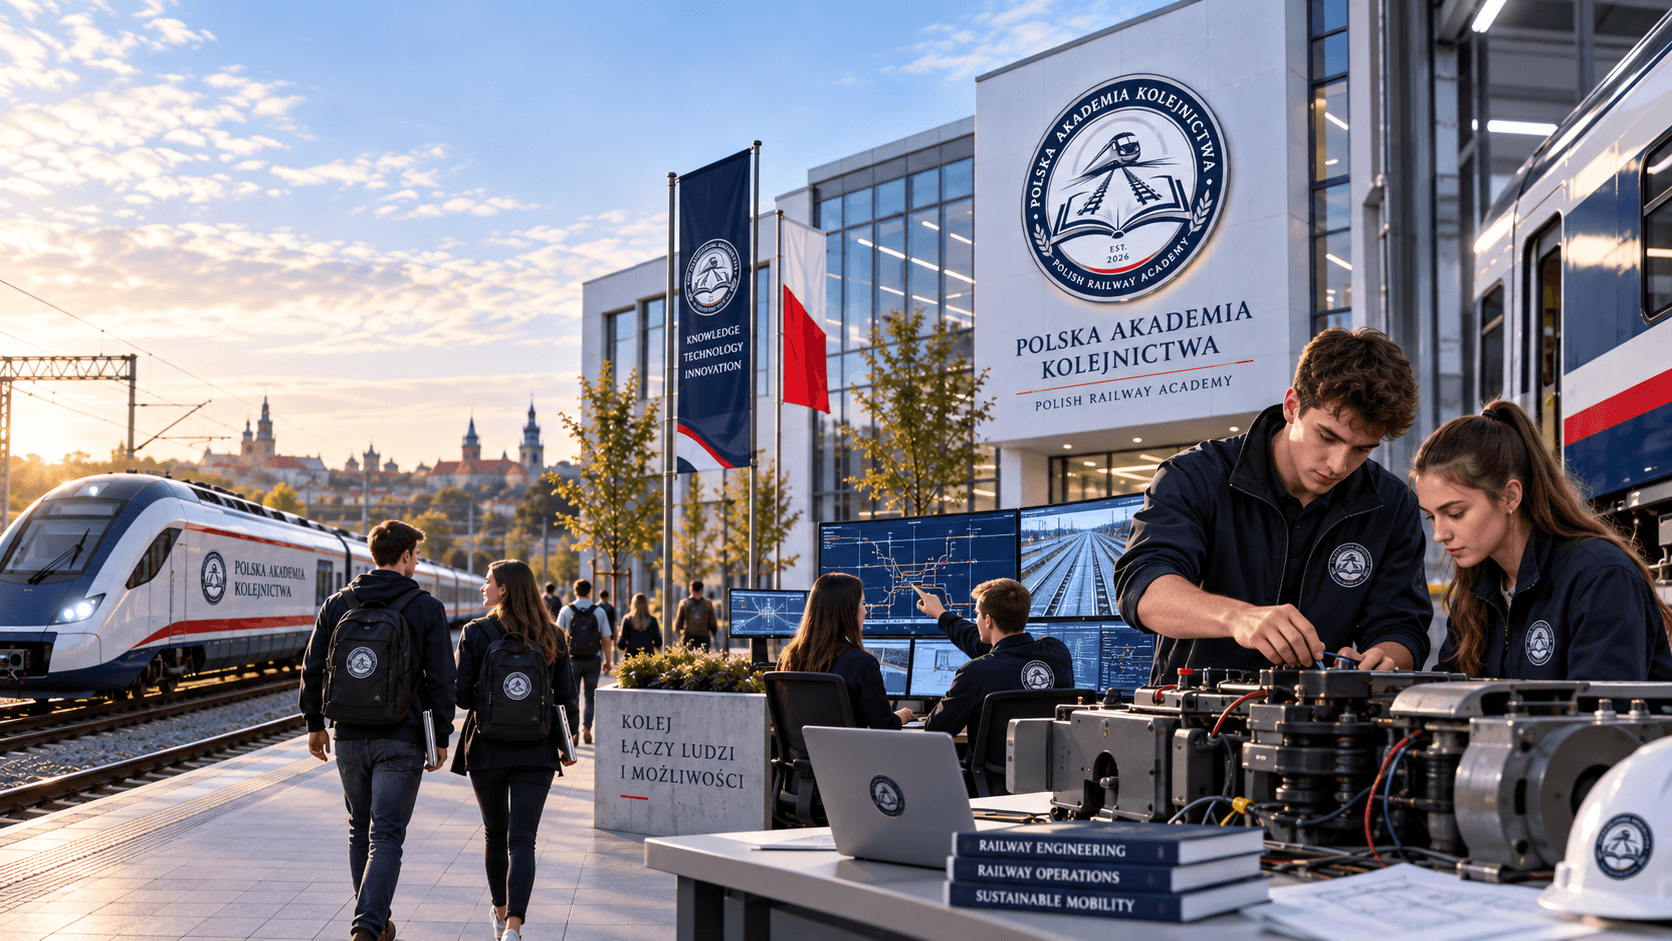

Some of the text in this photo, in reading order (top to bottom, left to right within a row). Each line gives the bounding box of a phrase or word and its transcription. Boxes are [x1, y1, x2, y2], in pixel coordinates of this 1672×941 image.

[1030, 86, 1216, 208] POLSKA AKADEMIA KOLEJNICTWA
[1109, 243, 1127, 253] EST.
[1052, 237, 1189, 290] POLISH RAILWAY ACADEMY
[1106, 253, 1129, 264] 2026
[686, 325, 740, 345] KNOWLEDGE
[1016, 300, 1253, 356] POLSKA AKADEMIA
[683, 342, 744, 362] TECHNOLOGY
[1041, 335, 1220, 379] KOLEJNICTWA
[685, 360, 742, 379] INNOVATION
[1035, 375, 1233, 411] POLISH RAILWAY ACADEMY
[234, 560, 305, 580] POLSKA AKADEMIA
[234, 582, 292, 599] KOLEJNICTWA
[621, 714, 672, 734] KOLEJ
[621, 739, 735, 761] ŁĄCZY LUDZI
[620, 764, 744, 789] I MOŻLIWOŚCI
[979, 839, 1126, 858] RAILWAY ENGINEERING
[977, 864, 1120, 884] RAILWAY OPERATIONS
[975, 889, 1135, 913] SUSTAINABLE MOBILITY
